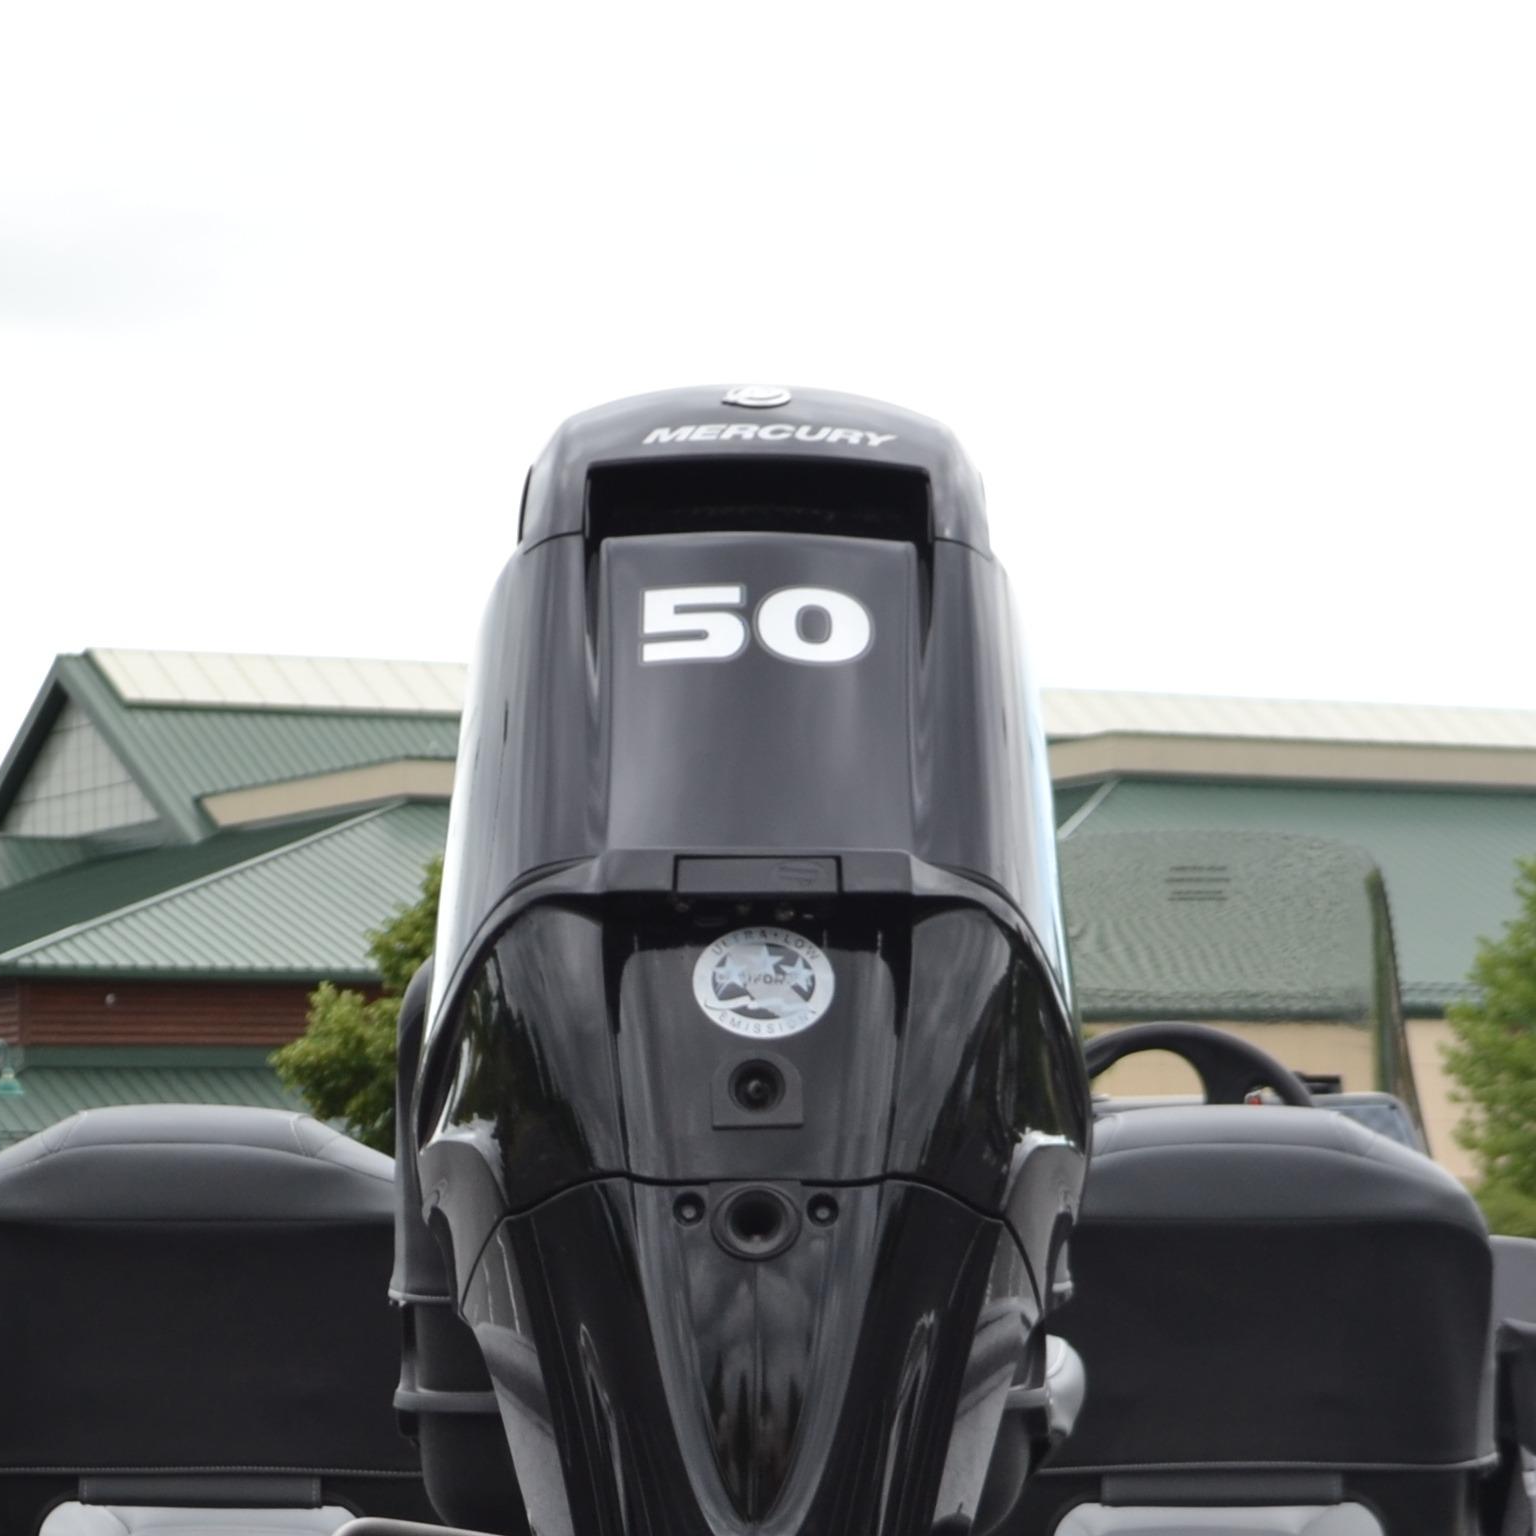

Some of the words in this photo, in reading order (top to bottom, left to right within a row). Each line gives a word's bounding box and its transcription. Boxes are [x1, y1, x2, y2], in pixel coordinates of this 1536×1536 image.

[643, 423, 898, 448] MERCURY
[641, 584, 873, 664] 50
[711, 928, 769, 957] ULTRA
[783, 933, 821, 961] LOW
